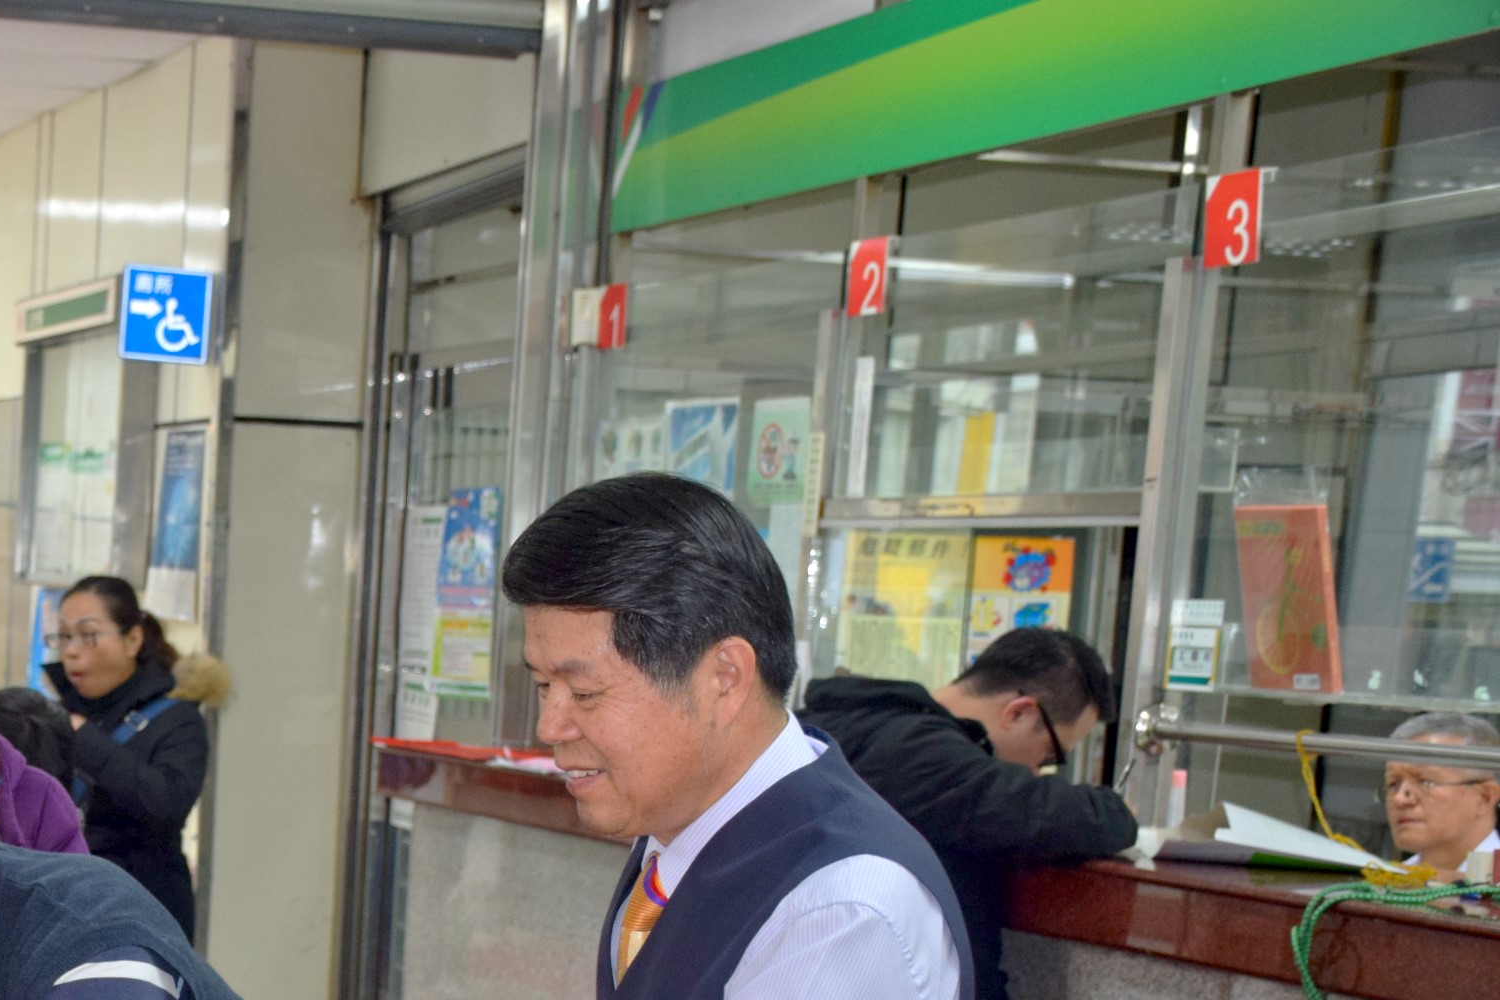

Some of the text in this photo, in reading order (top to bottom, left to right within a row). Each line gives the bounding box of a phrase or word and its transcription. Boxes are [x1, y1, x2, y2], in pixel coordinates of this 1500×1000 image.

[1224, 198, 1249, 266] 3
[861, 261, 880, 315] 2
[609, 302, 621, 348] 1
